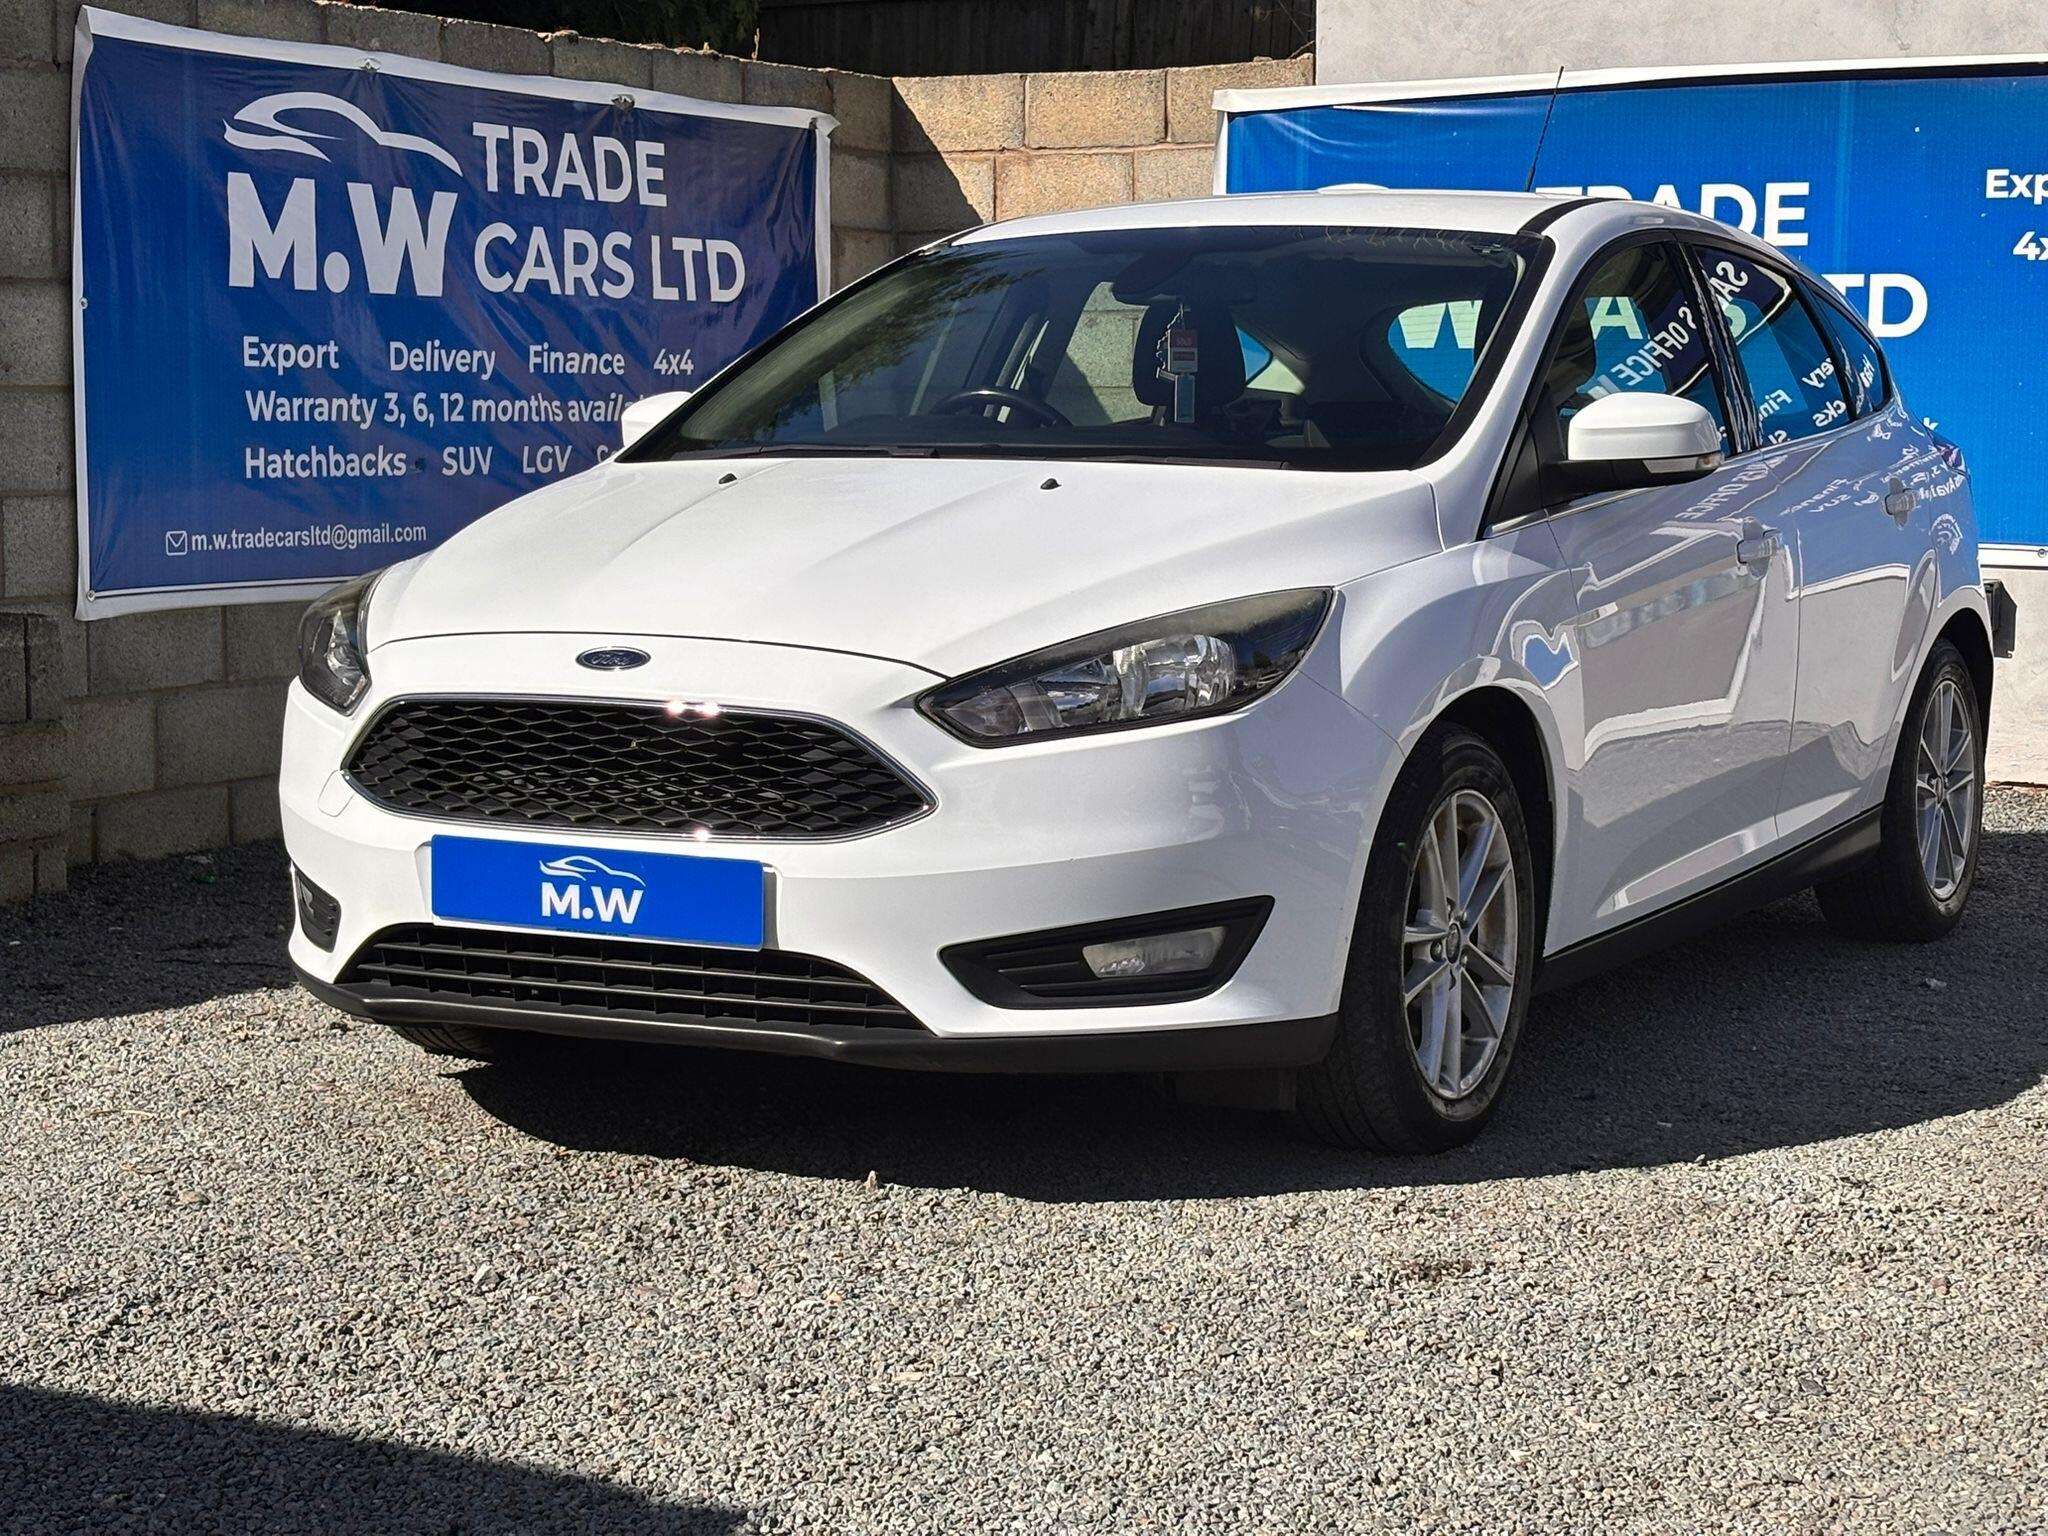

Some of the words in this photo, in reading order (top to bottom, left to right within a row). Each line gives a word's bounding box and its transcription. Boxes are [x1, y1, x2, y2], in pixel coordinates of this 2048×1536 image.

[473, 121, 668, 208] TRADE
[227, 171, 459, 297] M.W
[474, 222, 635, 300] CARS
[650, 235, 747, 303] LTD
[1820, 273, 1928, 339] TD
[243, 336, 340, 375] Export
[389, 339, 496, 380] Delivery
[529, 342, 626, 375] Finance
[653, 348, 695, 376] 4x4
[245, 390, 378, 430] Warranty
[384, 392, 406, 427] 3,
[413, 392, 435, 427] 6,
[440, 392, 464, 422] 12
[472, 393, 564, 422] months
[567, 392, 633, 422] avail
[245, 445, 407, 479] Hatchbacks
[441, 446, 493, 476] SUV
[522, 445, 573, 474] LGV
[191, 523, 428, 551] m.w.tradecarsltd@gmail.com
[541, 881, 645, 925] M.W
